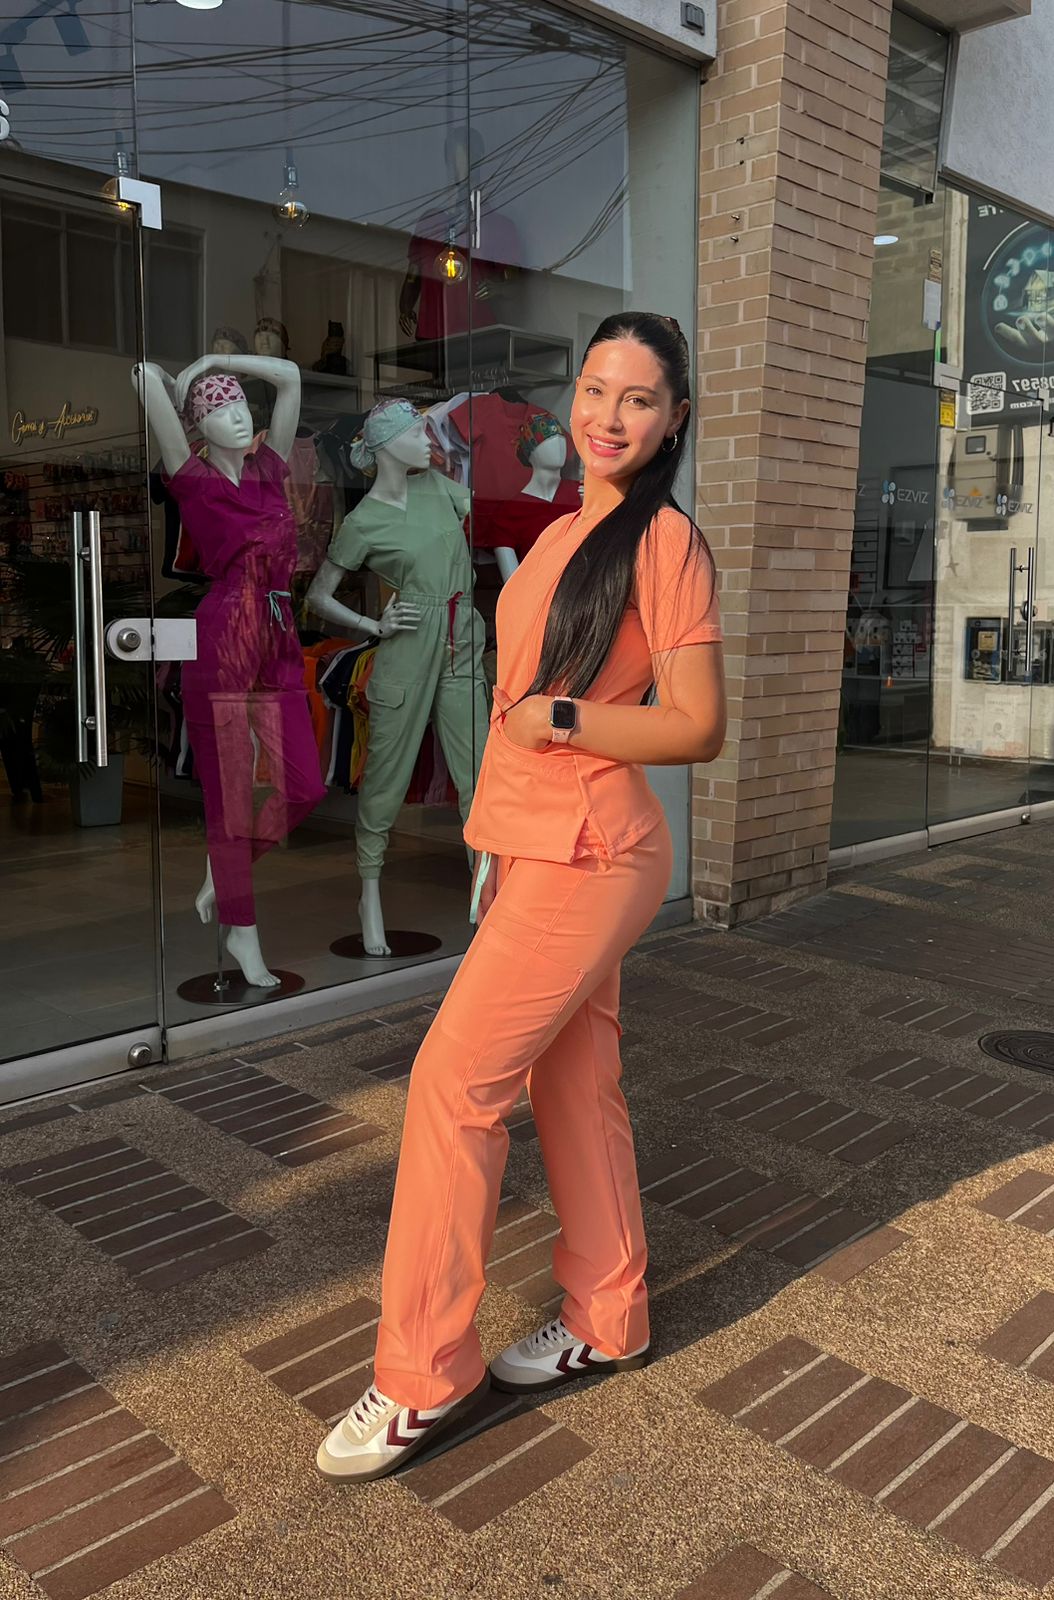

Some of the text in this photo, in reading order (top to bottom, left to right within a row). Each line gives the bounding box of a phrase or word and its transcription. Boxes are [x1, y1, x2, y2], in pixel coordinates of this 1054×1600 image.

[897, 488, 929, 504] EZVIZ
[956, 495, 983, 508] EZVIZ
[1008, 500, 1033, 514] EZVIZ
